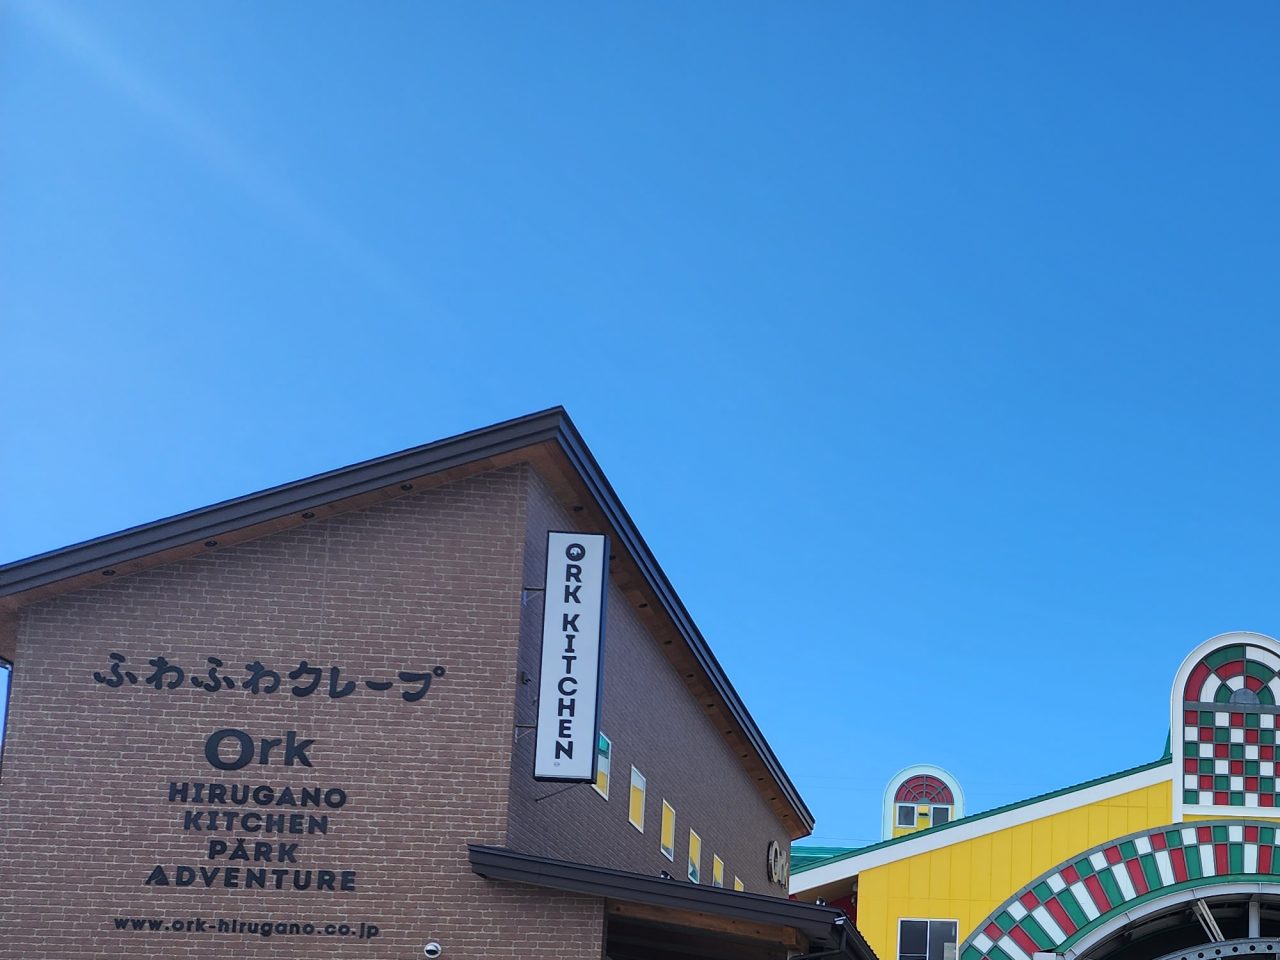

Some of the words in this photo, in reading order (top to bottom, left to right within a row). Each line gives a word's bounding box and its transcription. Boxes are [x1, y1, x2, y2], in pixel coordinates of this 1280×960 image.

[564, 543, 586, 604] ORK
[93, 652, 446, 702] ふわふわクレープ
[554, 613, 580, 760] KITCHEN
[204, 728, 316, 771] Ork
[168, 782, 347, 809] HIRUGANO
[183, 810, 328, 835] KITCHEN
[207, 838, 299, 864] PARK
[145, 865, 357, 892] ADVENTURE
[114, 918, 380, 939] www.ork-hirugano.co.jp
